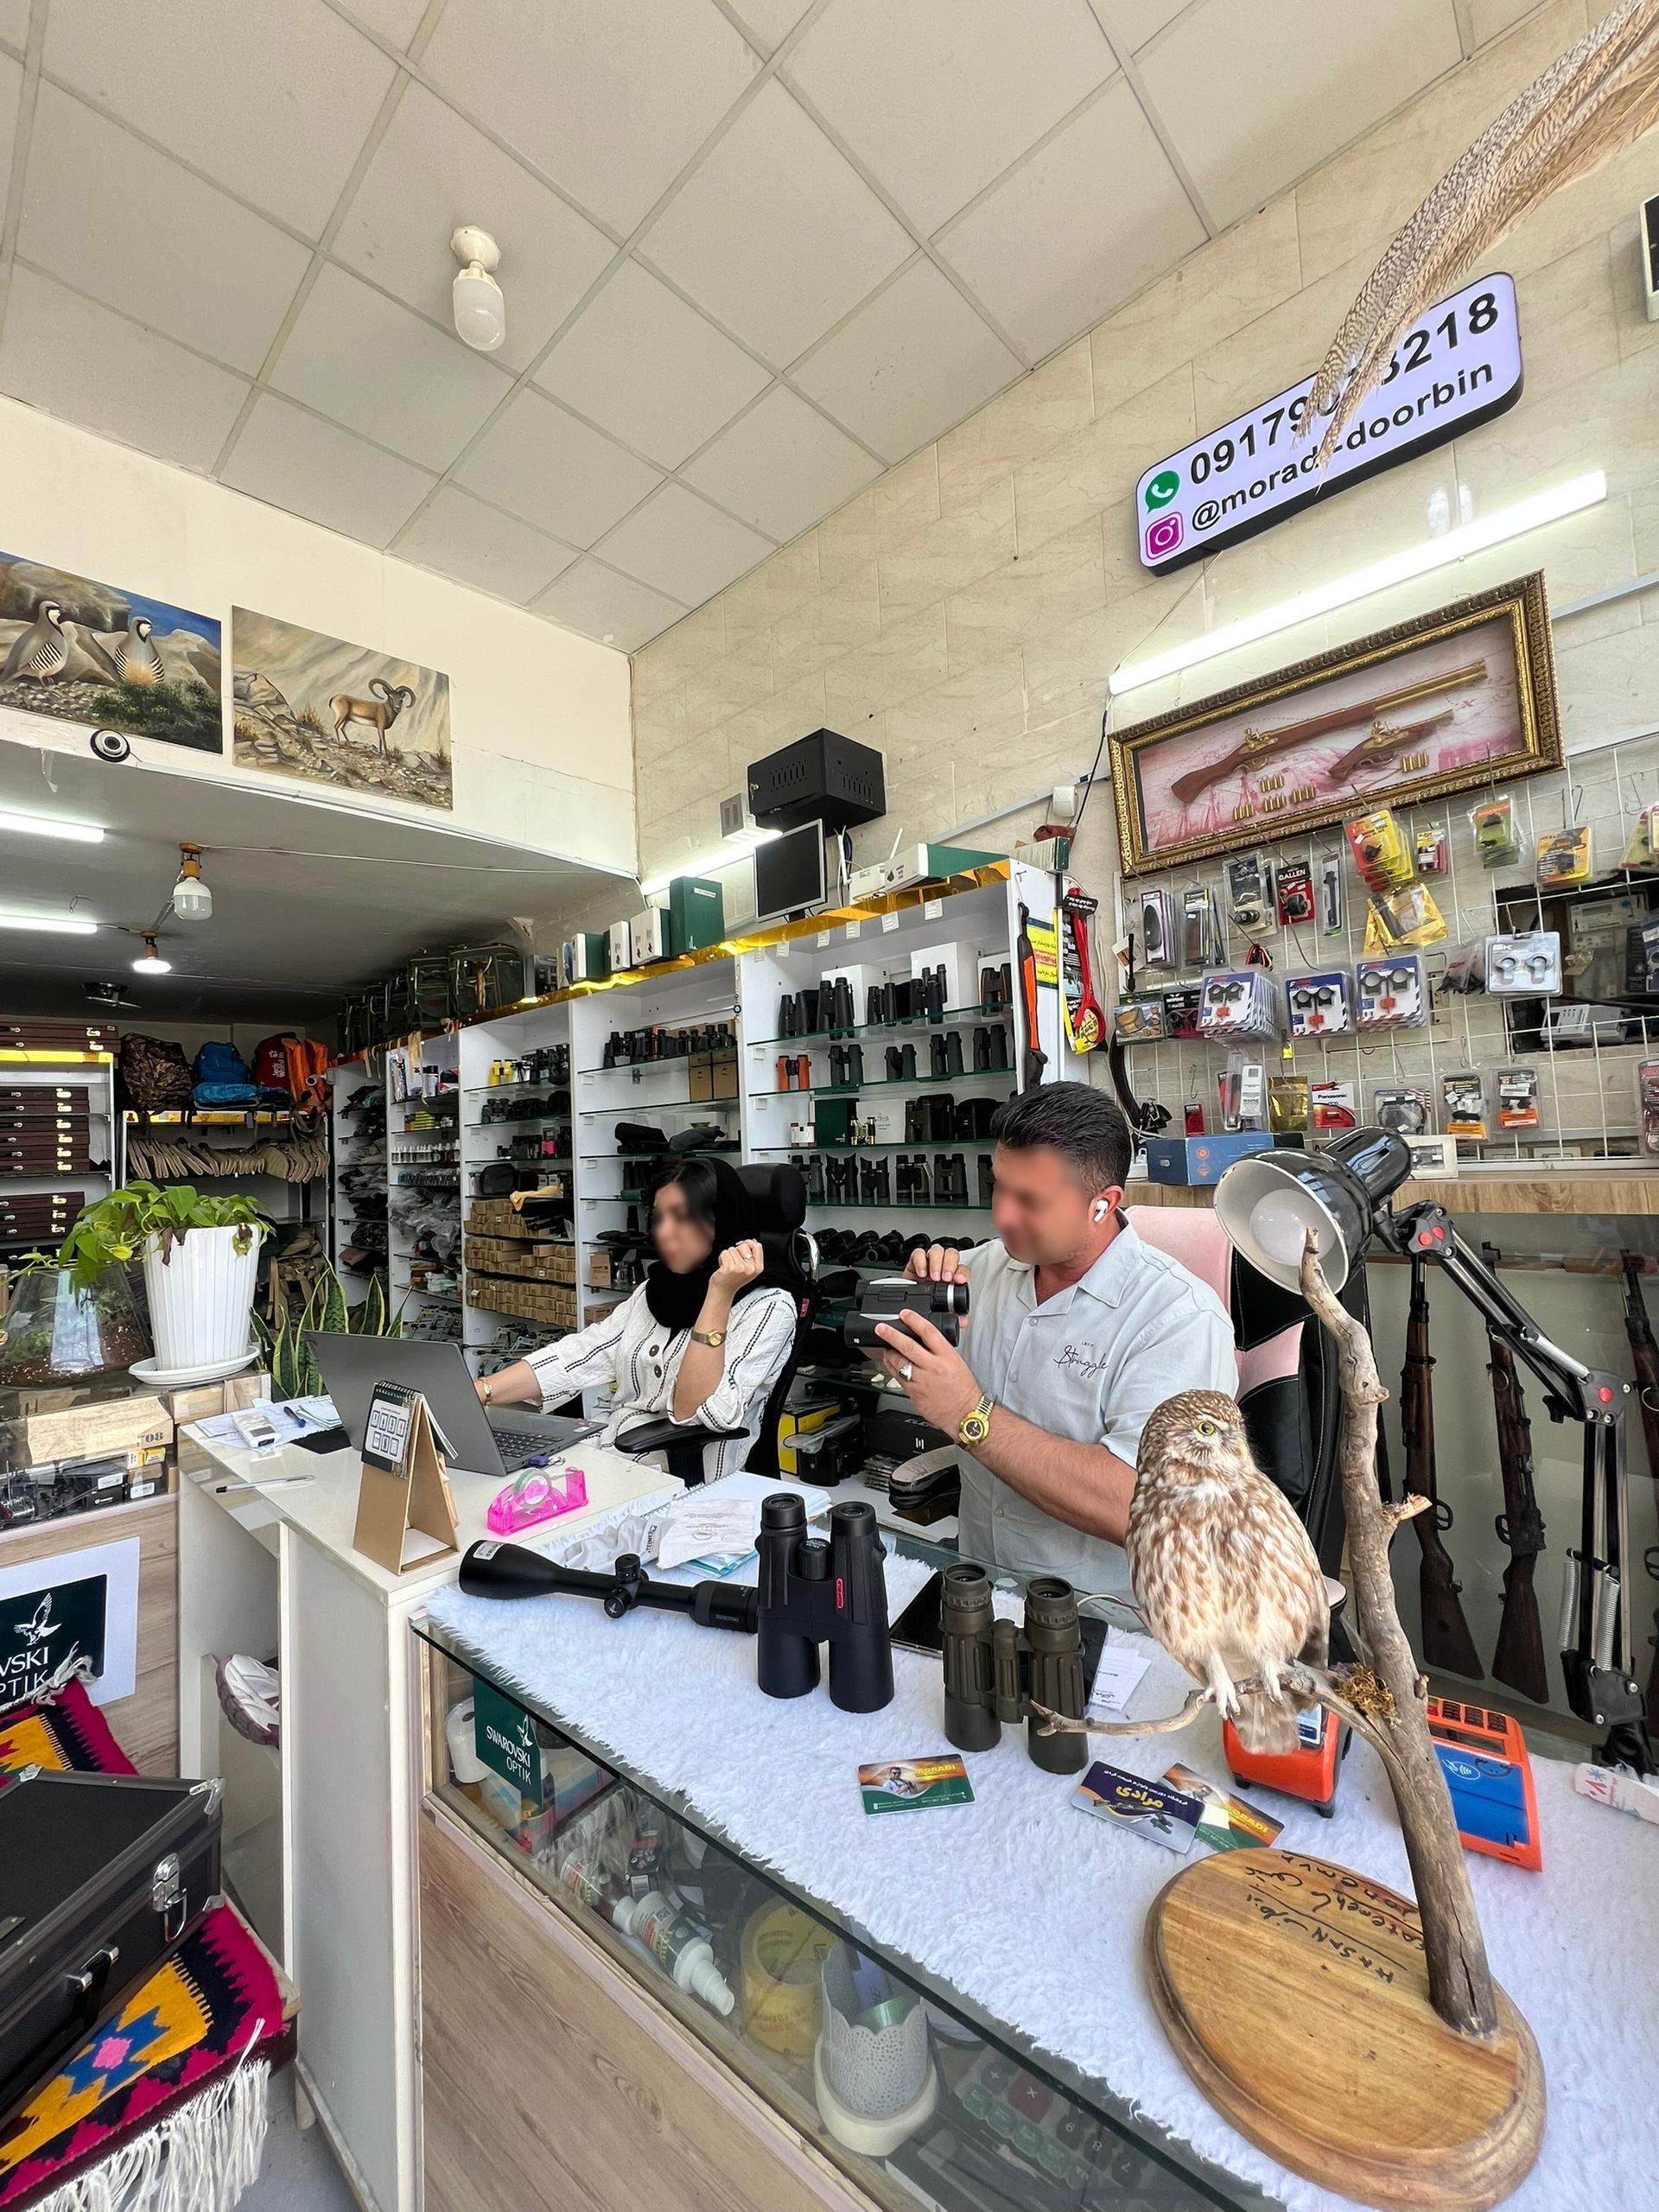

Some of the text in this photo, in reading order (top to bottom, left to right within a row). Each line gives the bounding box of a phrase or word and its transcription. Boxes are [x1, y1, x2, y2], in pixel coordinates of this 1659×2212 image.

[1192, 362, 1492, 531] @morad-doorbin
[1053, 1344, 1108, 1378] Struggle
[486, 1725, 531, 1768] SWAROVSKI
[506, 1756, 531, 1785] OPTIK
[1116, 1785, 1164, 1808] مرادی
